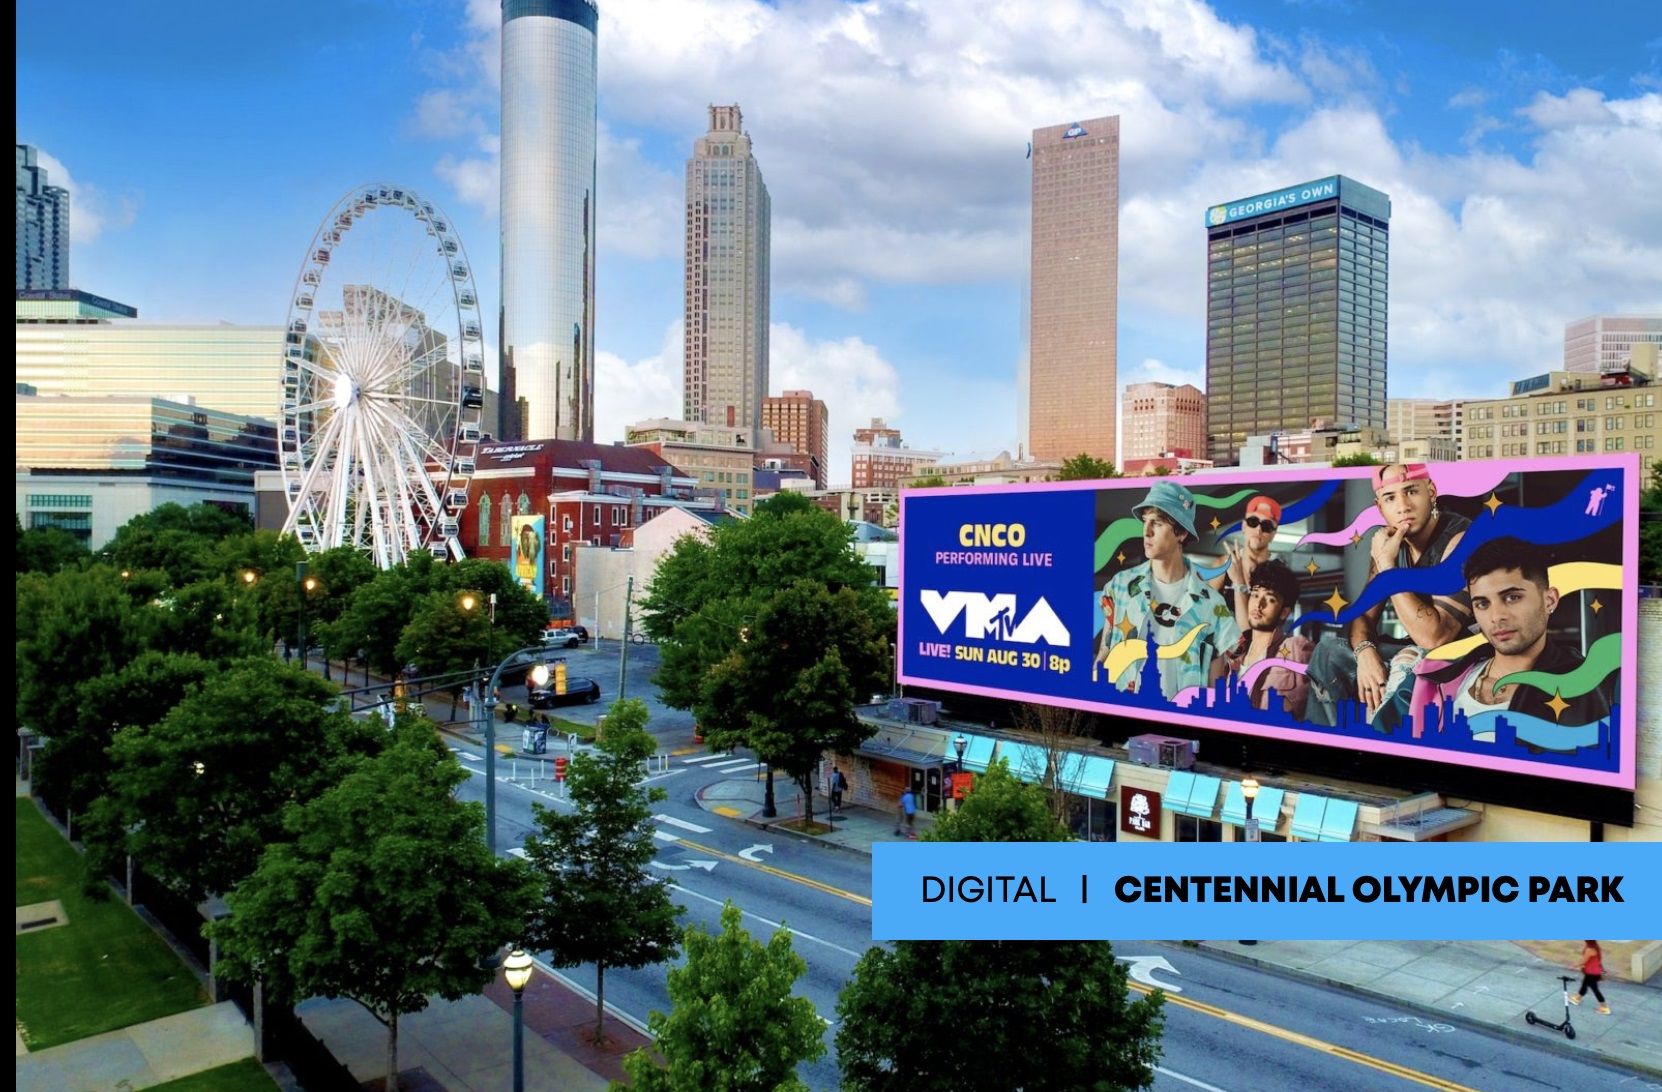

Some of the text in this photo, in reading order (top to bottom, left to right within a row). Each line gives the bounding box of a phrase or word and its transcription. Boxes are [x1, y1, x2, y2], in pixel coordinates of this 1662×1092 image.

[1067, 127, 1082, 137] GP
[1229, 183, 1334, 218] GEORGIA'S OWN
[480, 443, 545, 455] TABERNACLE
[959, 523, 1026, 548] CNCO
[935, 551, 1053, 567] PERFORMING LIVE
[919, 641, 1071, 675] LIVE! SUN AUG 30 8p
